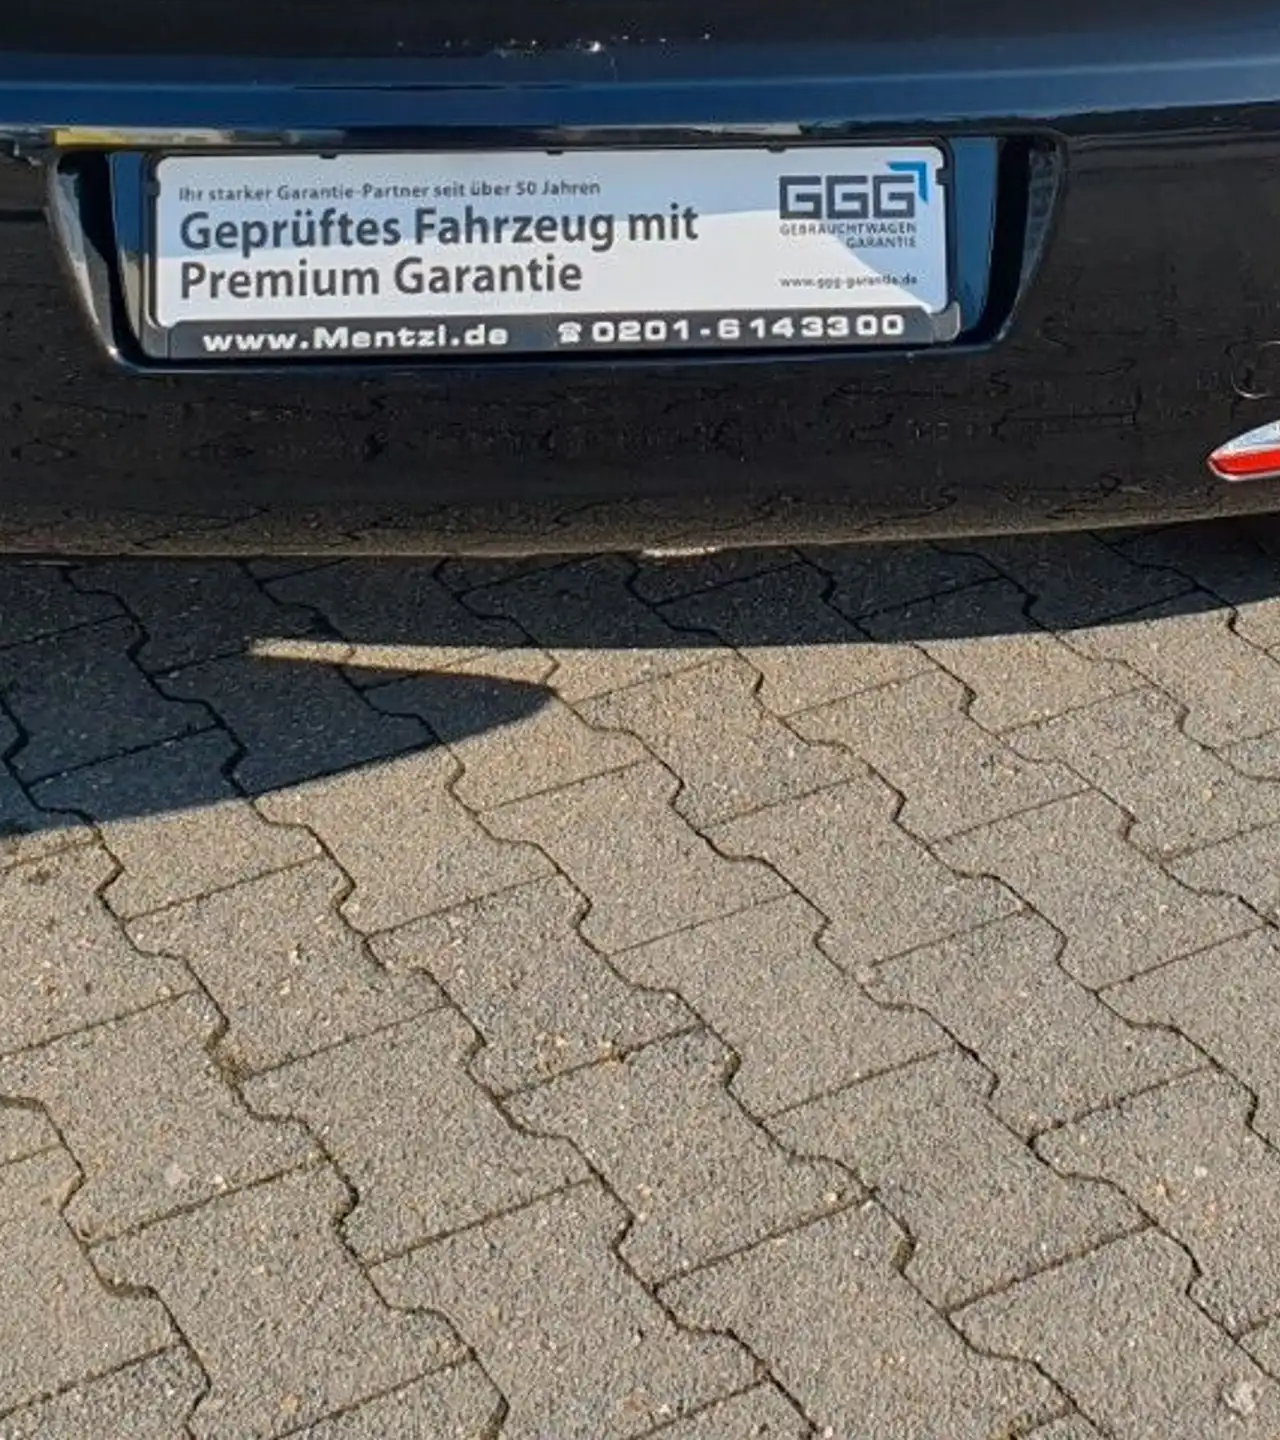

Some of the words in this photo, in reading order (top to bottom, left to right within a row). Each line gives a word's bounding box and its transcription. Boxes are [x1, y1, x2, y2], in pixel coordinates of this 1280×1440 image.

[178, 186, 202, 202] Ihr
[208, 184, 272, 201] starker
[433, 181, 466, 198] seit
[470, 180, 511, 197] über
[516, 180, 538, 196] 50
[541, 179, 601, 196] Jahren
[779, 175, 916, 220] GGG
[180, 208, 402, 259] Geprüftes
[414, 204, 615, 253] Fahrzeug
[628, 202, 699, 242] mit
[779, 221, 917, 236] GEBRAUCHTWAGEN
[845, 235, 917, 249] GARANTIE
[181, 257, 380, 299] Premium
[393, 253, 583, 295] Garantie
